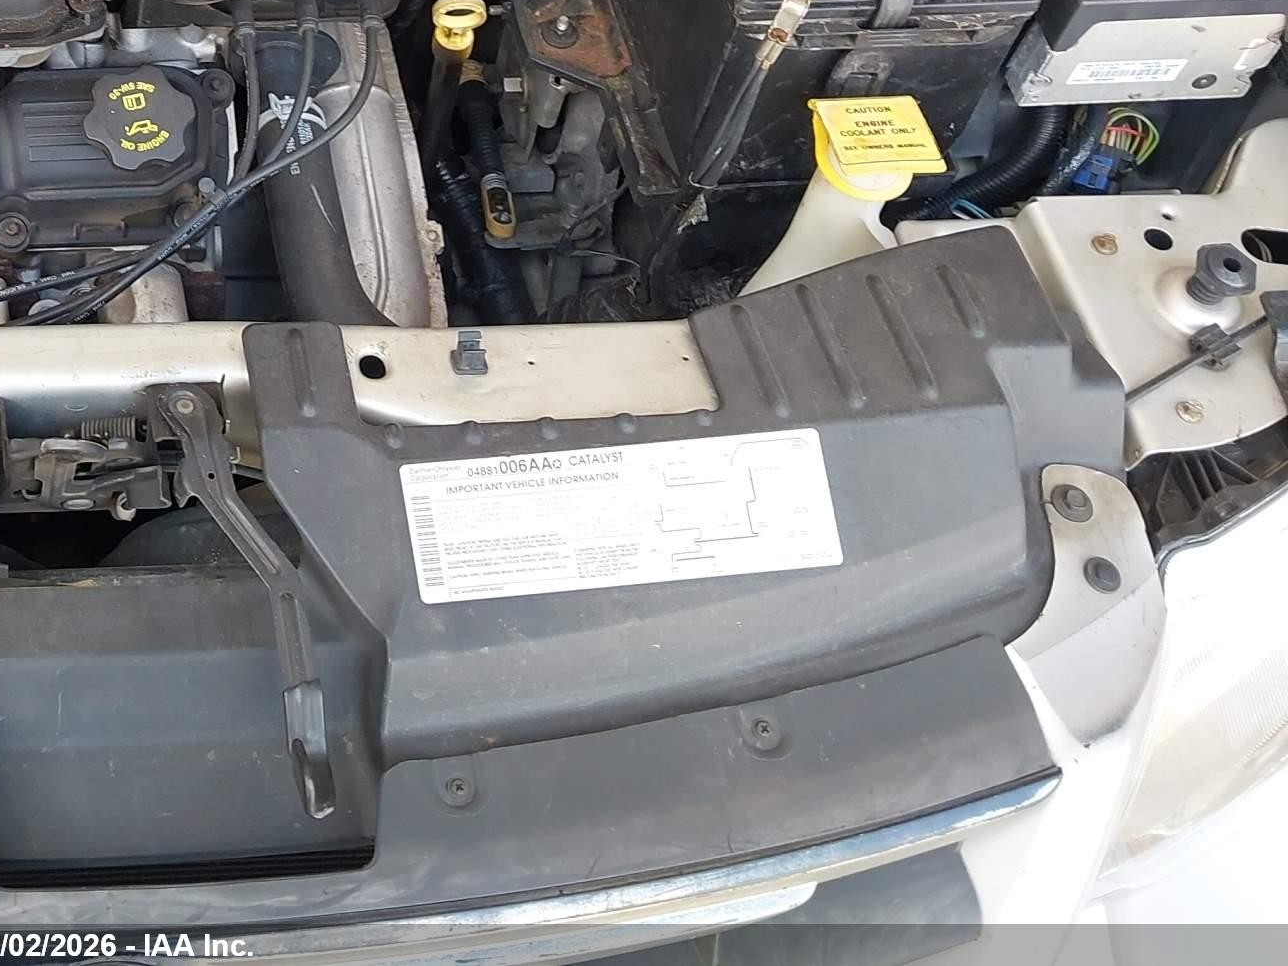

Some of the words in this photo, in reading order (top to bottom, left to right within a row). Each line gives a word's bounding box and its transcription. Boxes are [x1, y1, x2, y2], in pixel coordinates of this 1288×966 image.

[135, 81, 156, 94] SAE
[845, 106, 892, 115] CAUTION
[855, 119, 896, 128] ENGINE
[839, 128, 886, 137] COOLANT
[891, 127, 917, 135] ONLY
[120, 138, 136, 151] OIL
[136, 129, 170, 152] ENGINE
[568, 451, 624, 467] CATALYST
[445, 482, 503, 495] IMPORTANT
[506, 478, 546, 490] VEHICLE
[548, 471, 620, 486] INFORMATION
